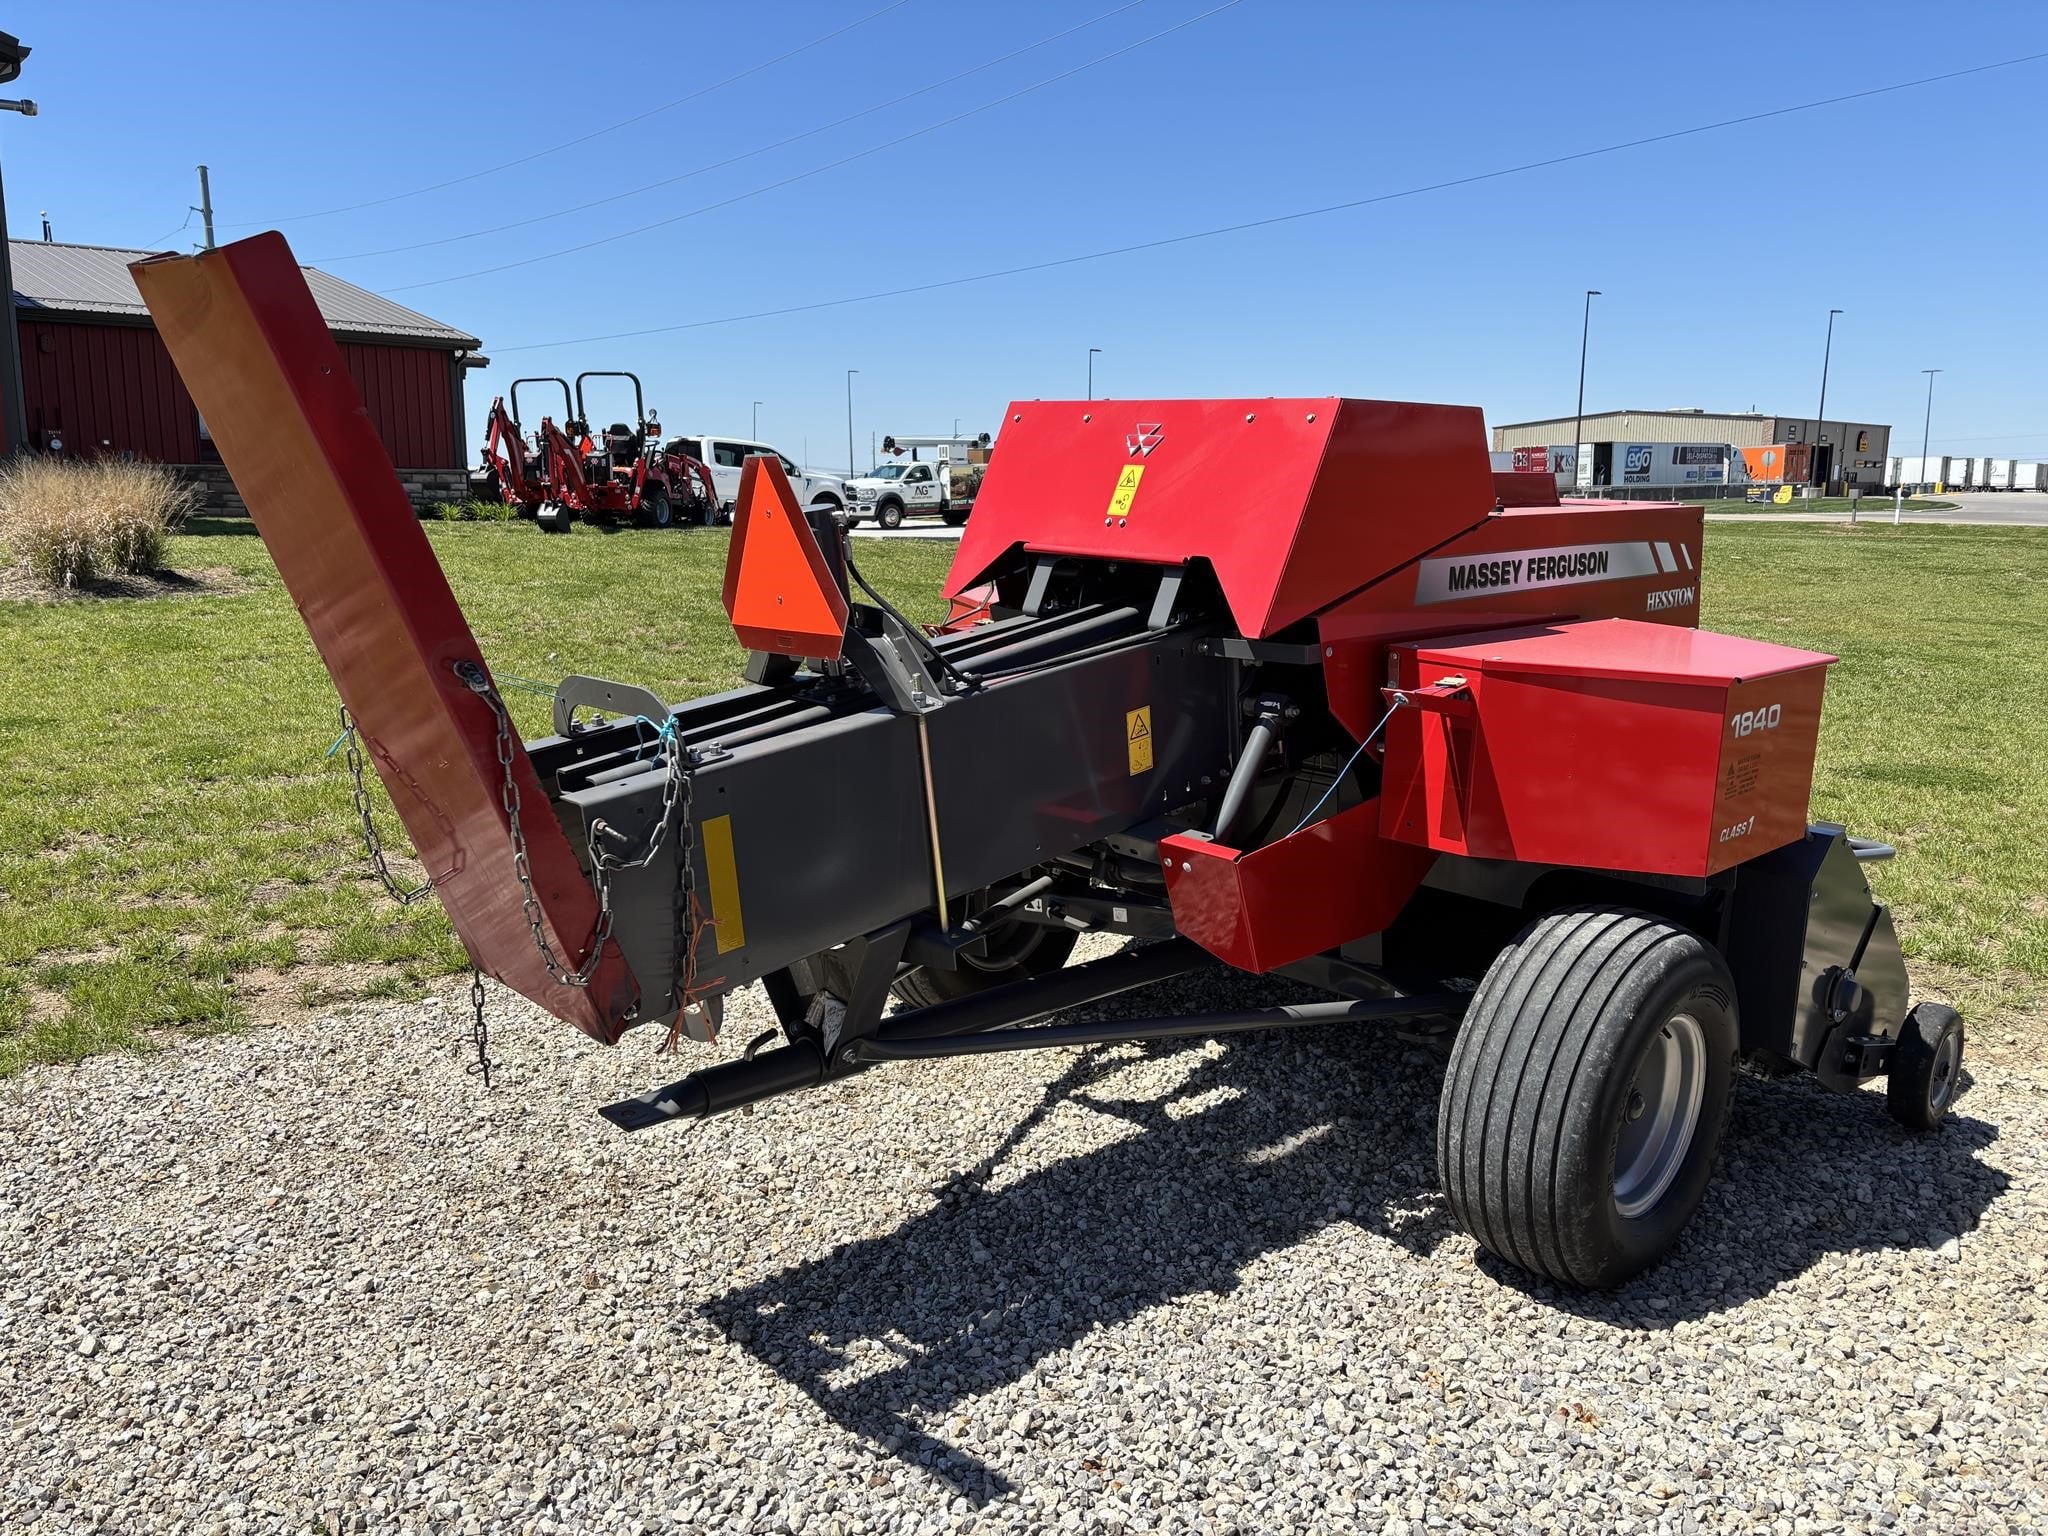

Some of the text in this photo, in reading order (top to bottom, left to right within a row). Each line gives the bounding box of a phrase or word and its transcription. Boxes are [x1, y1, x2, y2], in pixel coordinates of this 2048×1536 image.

[1624, 475, 1651, 484] HOLDING
[1448, 550, 1609, 593] MASSEY FERGUSON
[1646, 586, 1696, 611] HESSTON
[1731, 703, 1781, 739] 1840
[1719, 821, 1748, 843] CLASS
